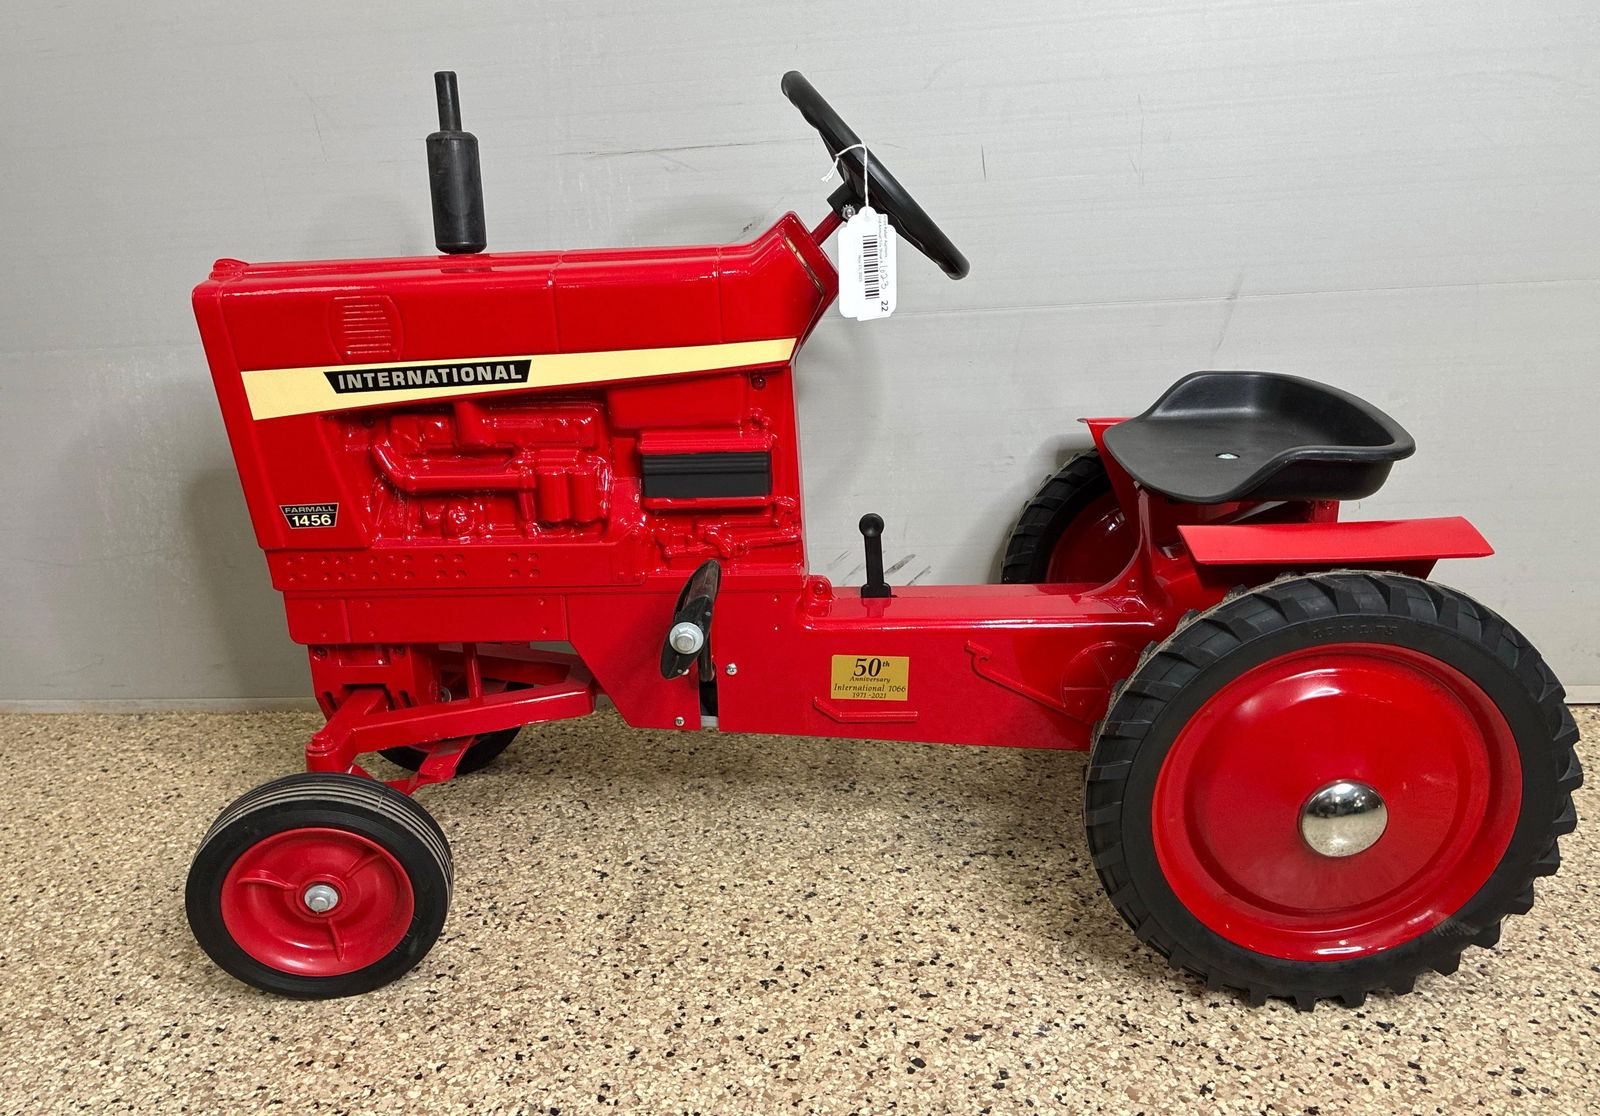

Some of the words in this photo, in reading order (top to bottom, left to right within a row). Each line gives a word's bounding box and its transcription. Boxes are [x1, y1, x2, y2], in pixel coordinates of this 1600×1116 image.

[881, 300, 889, 312] 22
[338, 364, 522, 389] INTERNATIONAL
[292, 514, 331, 526] 1456
[853, 658, 890, 677] 50th
[834, 683, 885, 692] International
